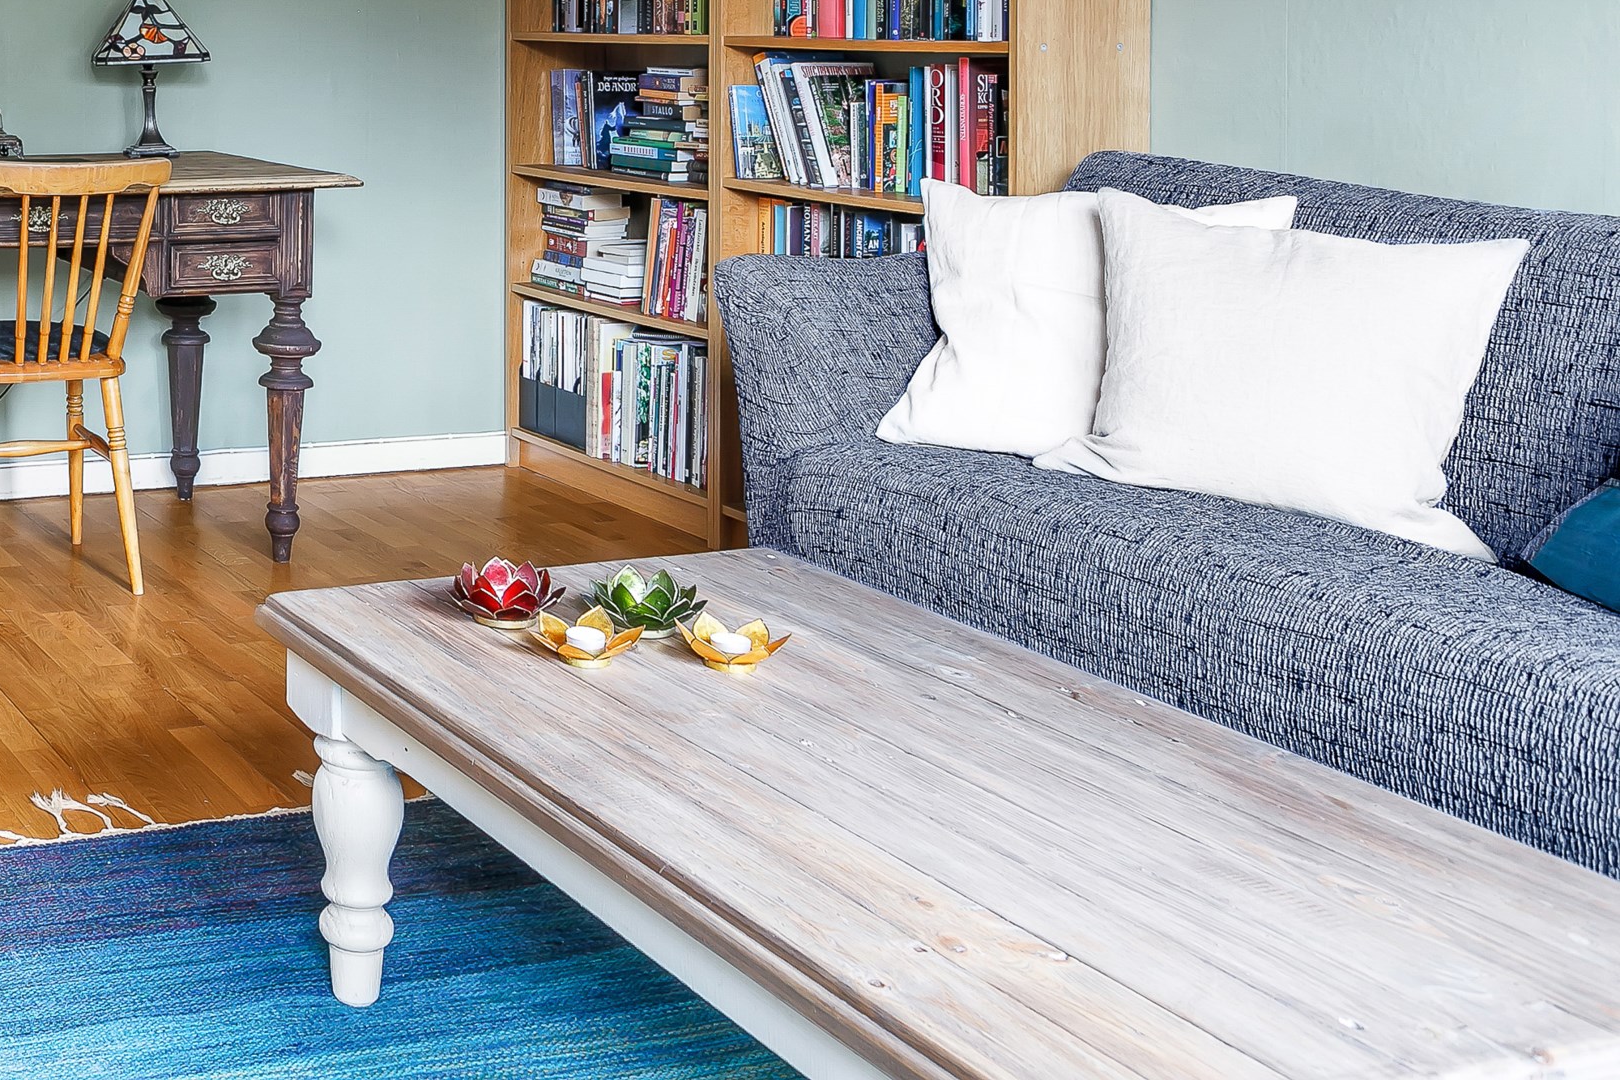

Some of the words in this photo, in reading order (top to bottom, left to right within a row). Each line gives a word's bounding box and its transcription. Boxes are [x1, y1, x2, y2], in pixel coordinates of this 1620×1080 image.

[611, 82, 637, 92] ANDR
[651, 105, 673, 115] STALLO
[803, 206, 811, 242] ROMAN
